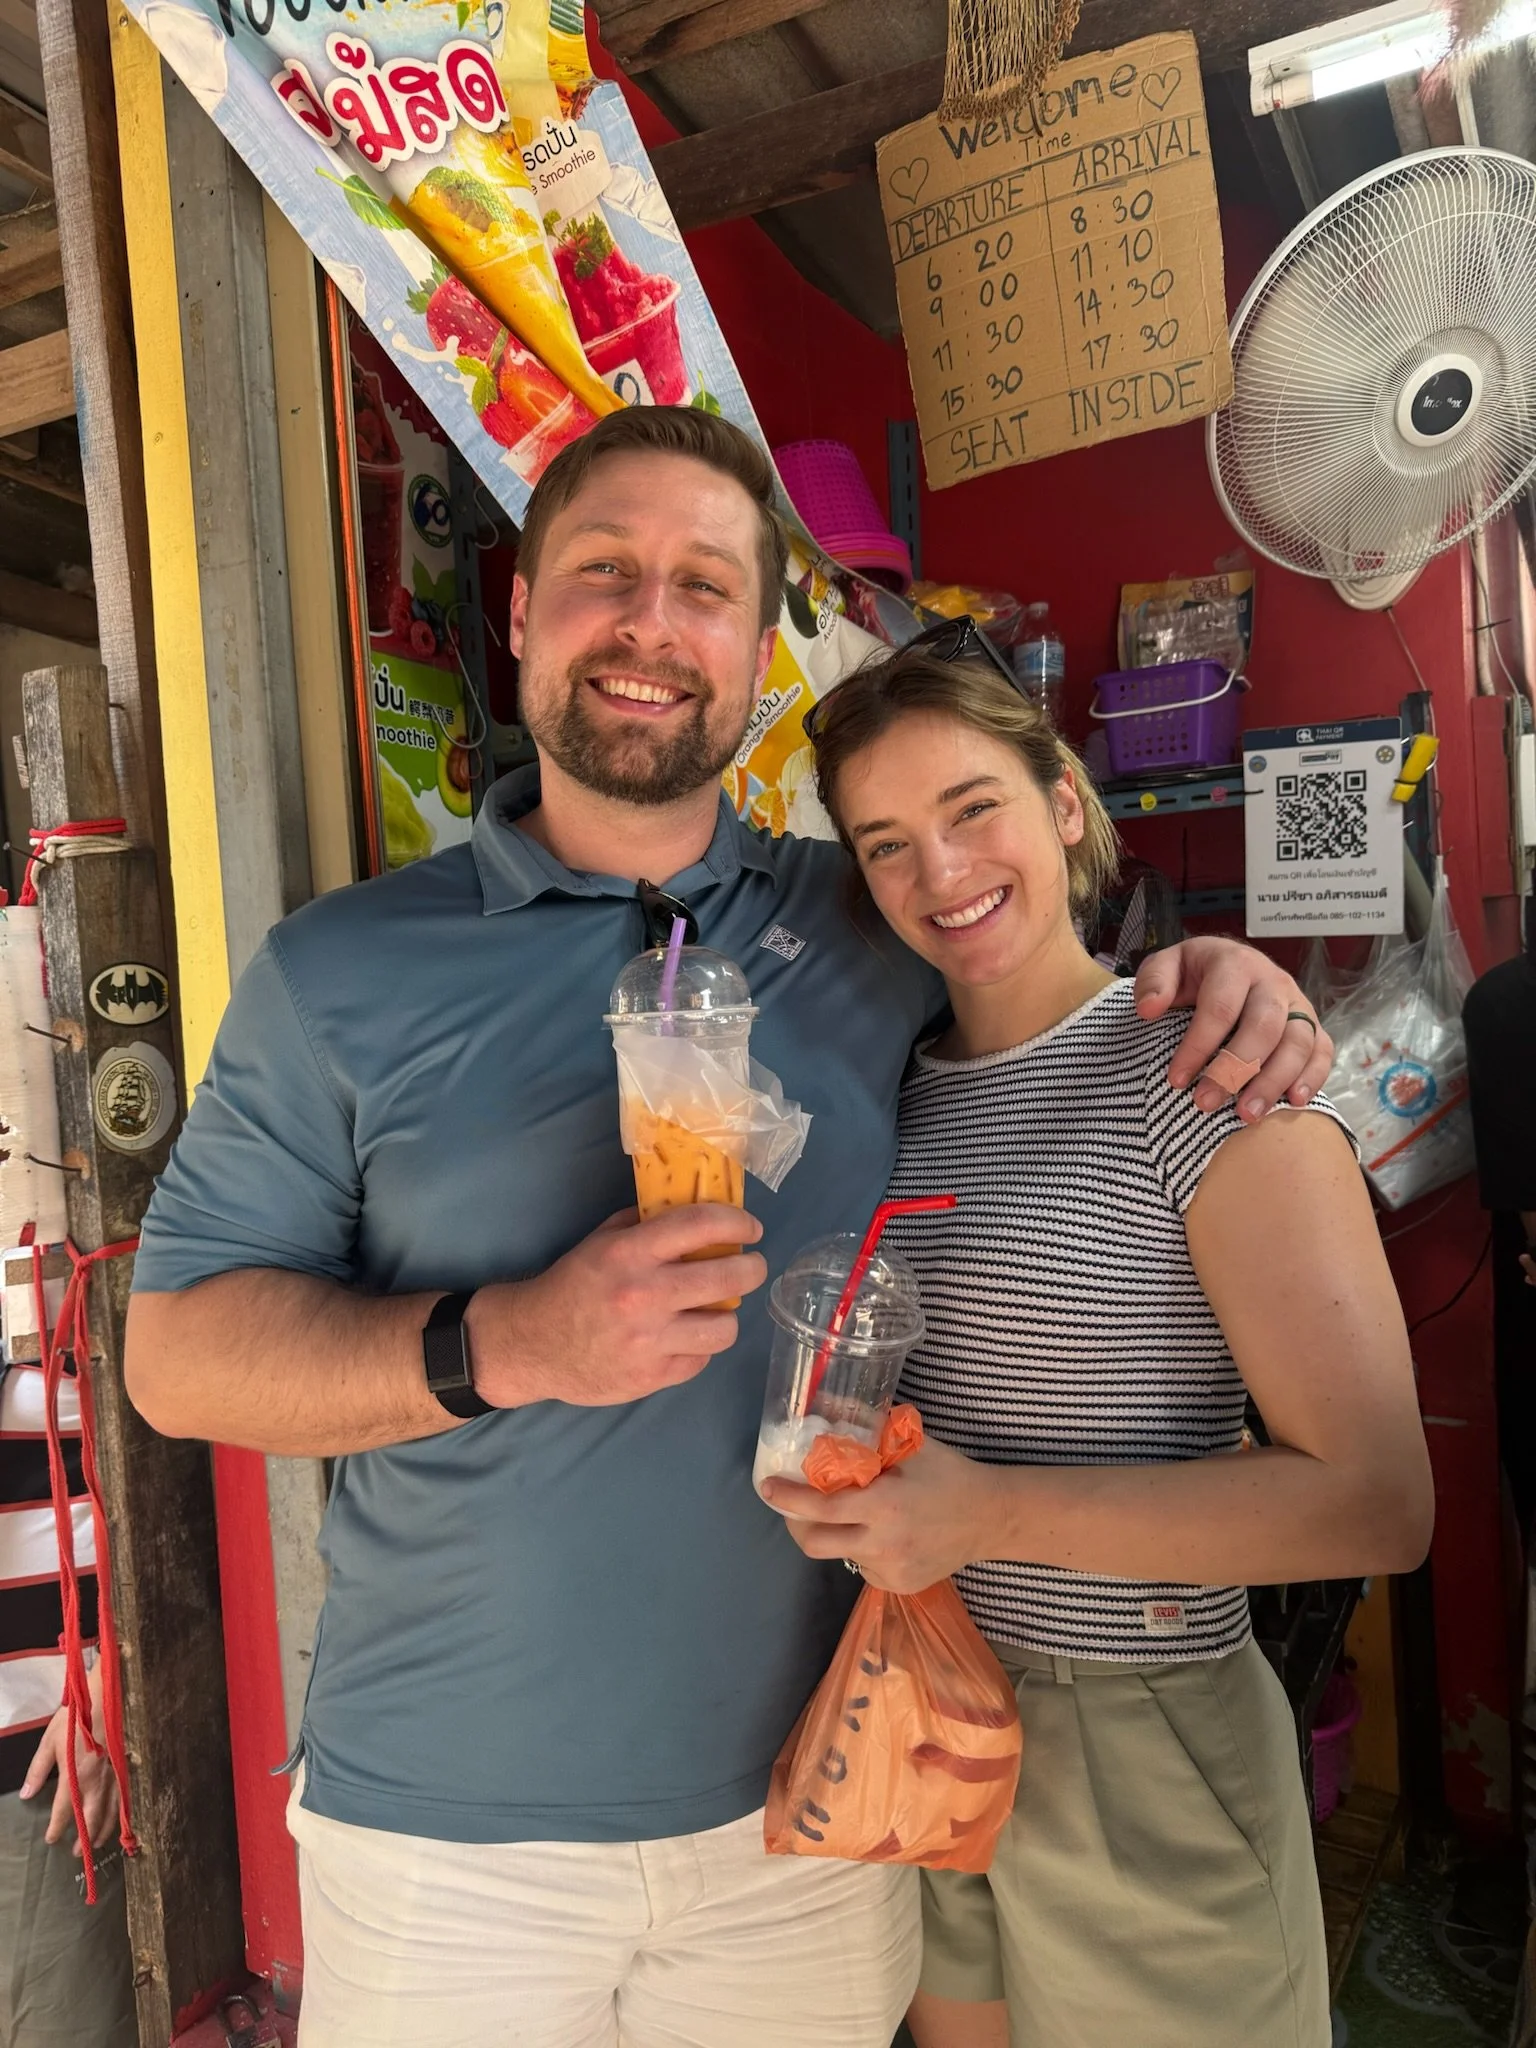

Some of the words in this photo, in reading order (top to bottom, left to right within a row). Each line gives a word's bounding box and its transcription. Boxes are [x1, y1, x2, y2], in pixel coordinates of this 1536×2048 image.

[938, 62, 1139, 160] Welcome
[1019, 131, 1072, 163] Time
[540, 149, 596, 189] Smoothie
[892, 174, 1026, 257] DEPARTURE
[1072, 118, 1201, 187] ARRIVAL
[950, 410, 1029, 473] SEAT
[1068, 361, 1205, 436] INSIDE
[737, 728, 764, 764] Orange
[764, 685, 801, 728] Smoothie
